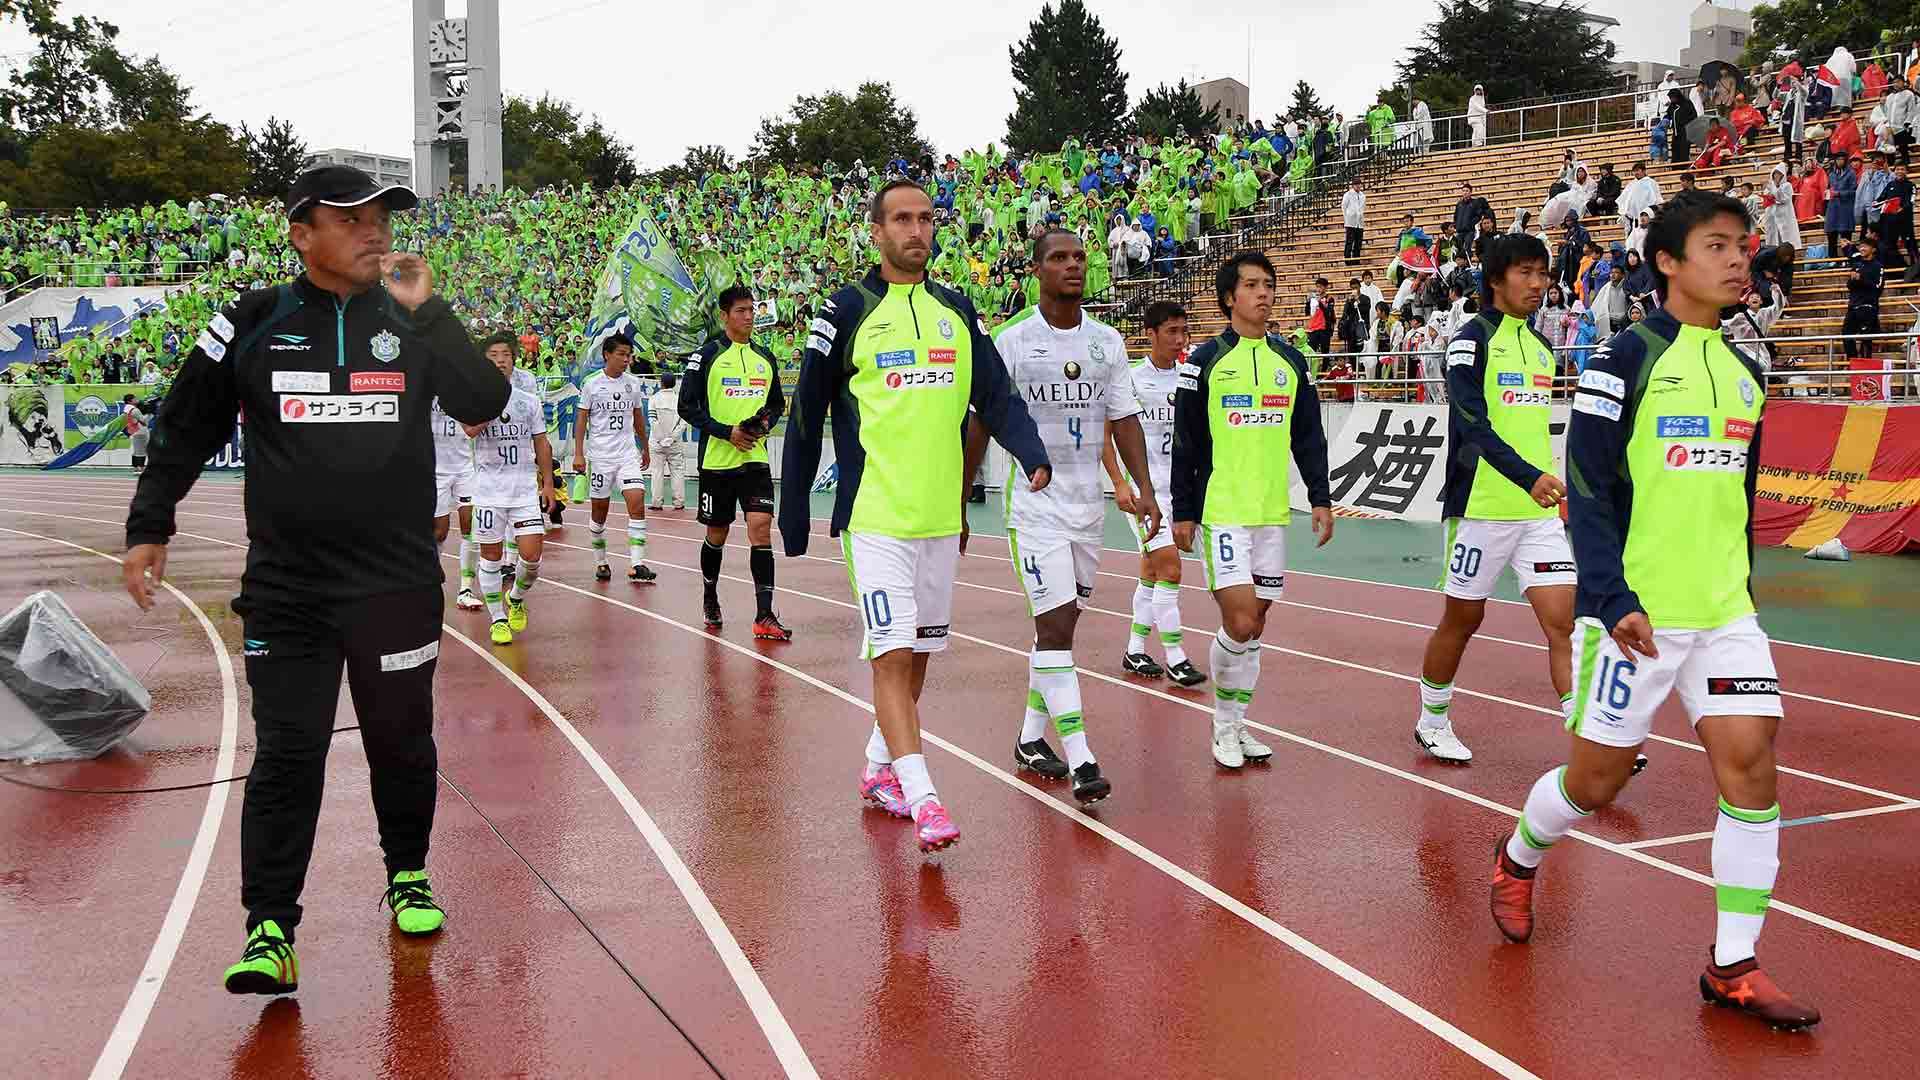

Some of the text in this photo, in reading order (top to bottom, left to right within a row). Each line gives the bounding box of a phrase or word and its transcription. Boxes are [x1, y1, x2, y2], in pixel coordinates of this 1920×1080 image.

[353, 378, 402, 386] RANTEC
[609, 415, 624, 430] 29
[1142, 407, 1174, 421] MEL
[443, 420, 456, 437] 13
[1068, 416, 1082, 451] 4
[1162, 432, 1171, 455] 2
[498, 445, 518, 465] 40
[591, 472, 604, 488] 29
[1759, 464, 1792, 479] SHOW
[1796, 470, 1809, 480] US
[702, 492, 713, 514] 31
[1754, 489, 1783, 502] YOUR
[1787, 495, 1817, 506] BEST
[476, 508, 493, 529] 40
[1219, 532, 1234, 562] 6
[1024, 555, 1043, 586] 4
[1450, 543, 1482, 578] 30
[863, 589, 892, 629] 10
[1596, 655, 1637, 710] 16
